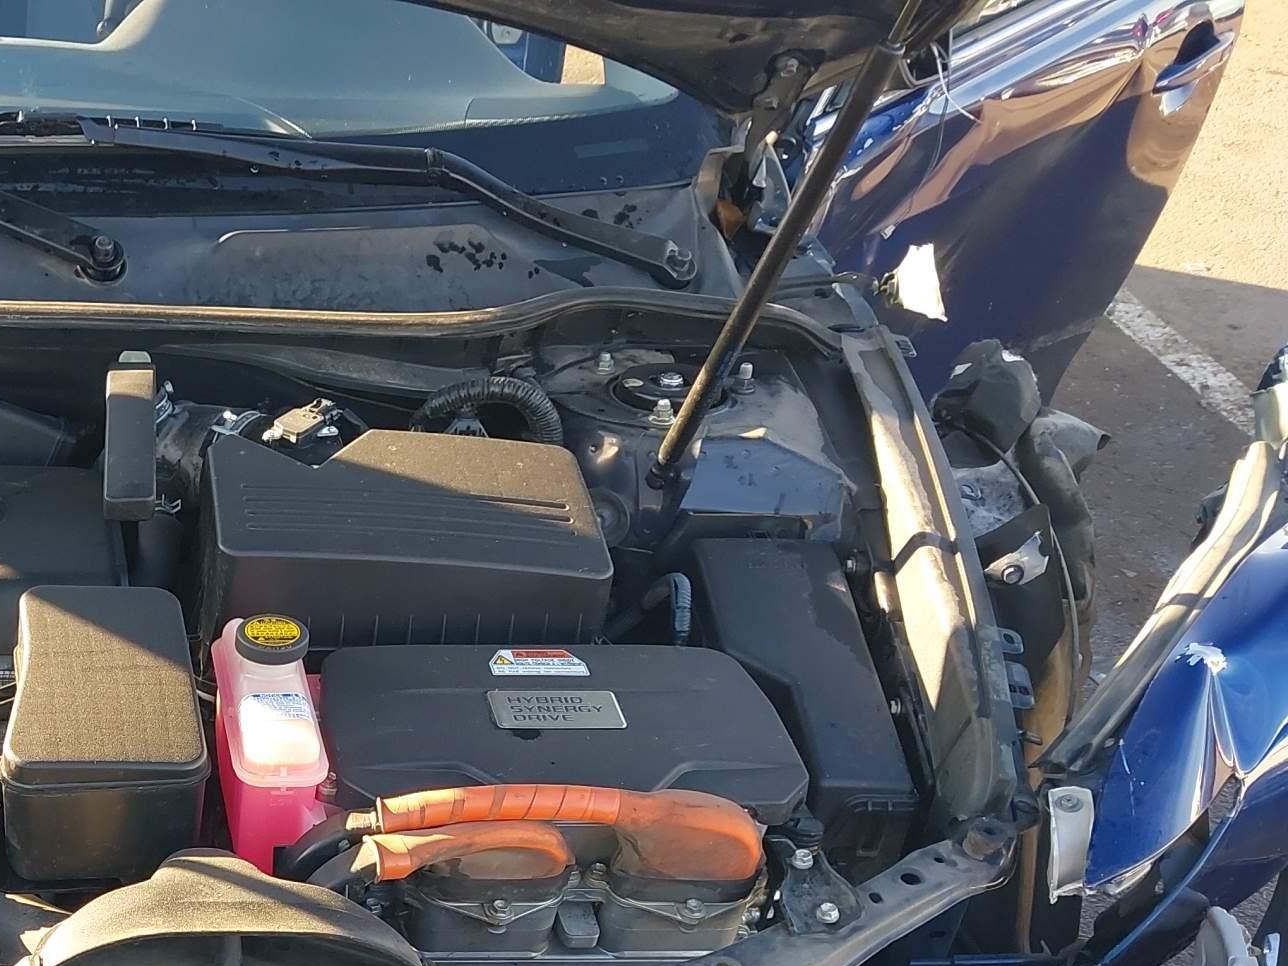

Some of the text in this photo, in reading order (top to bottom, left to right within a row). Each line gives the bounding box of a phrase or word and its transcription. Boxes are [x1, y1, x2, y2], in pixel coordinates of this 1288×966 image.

[506, 696, 584, 704] HYBRID
[510, 705, 603, 713] SYNERGY
[512, 714, 576, 722] DRIVE
